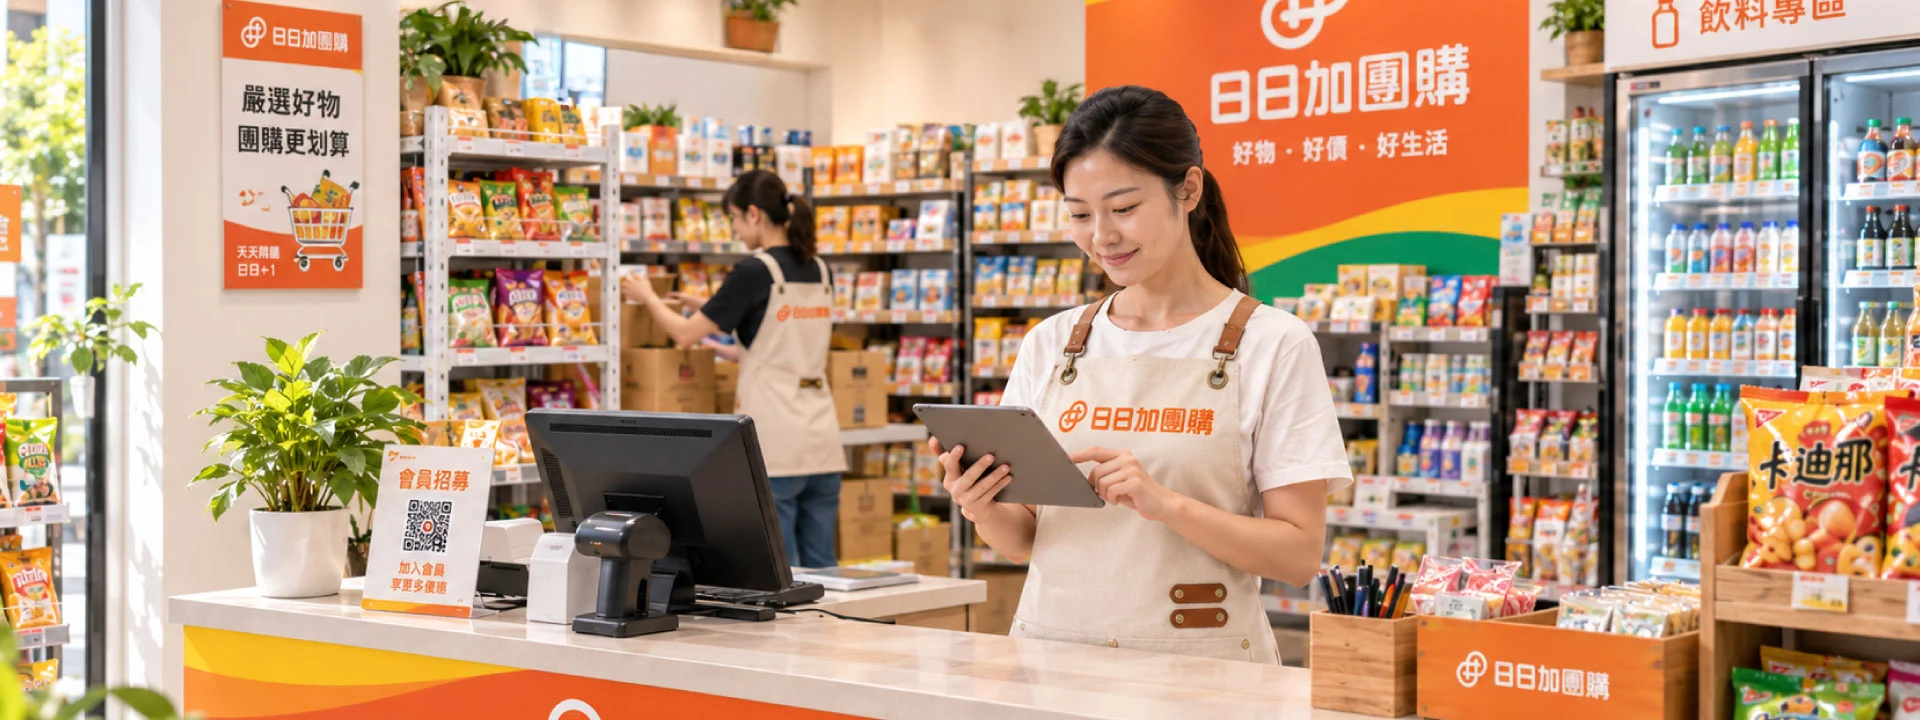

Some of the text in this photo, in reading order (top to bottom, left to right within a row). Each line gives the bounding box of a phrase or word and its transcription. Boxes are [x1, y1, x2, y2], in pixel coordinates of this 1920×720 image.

[272, 26, 348, 53] 日日加團購
[1211, 43, 1470, 124] 日日加團購
[242, 84, 340, 119] 嚴選好物
[238, 125, 350, 157] 團購更划算
[238, 263, 276, 277] 日日+1
[1091, 406, 1215, 436] 日日加團購
[400, 467, 470, 491] 會員招募
[1759, 437, 1873, 491] 卡迪那
[398, 560, 445, 577] 加入會員
[1495, 661, 1610, 700] 日日加團購
